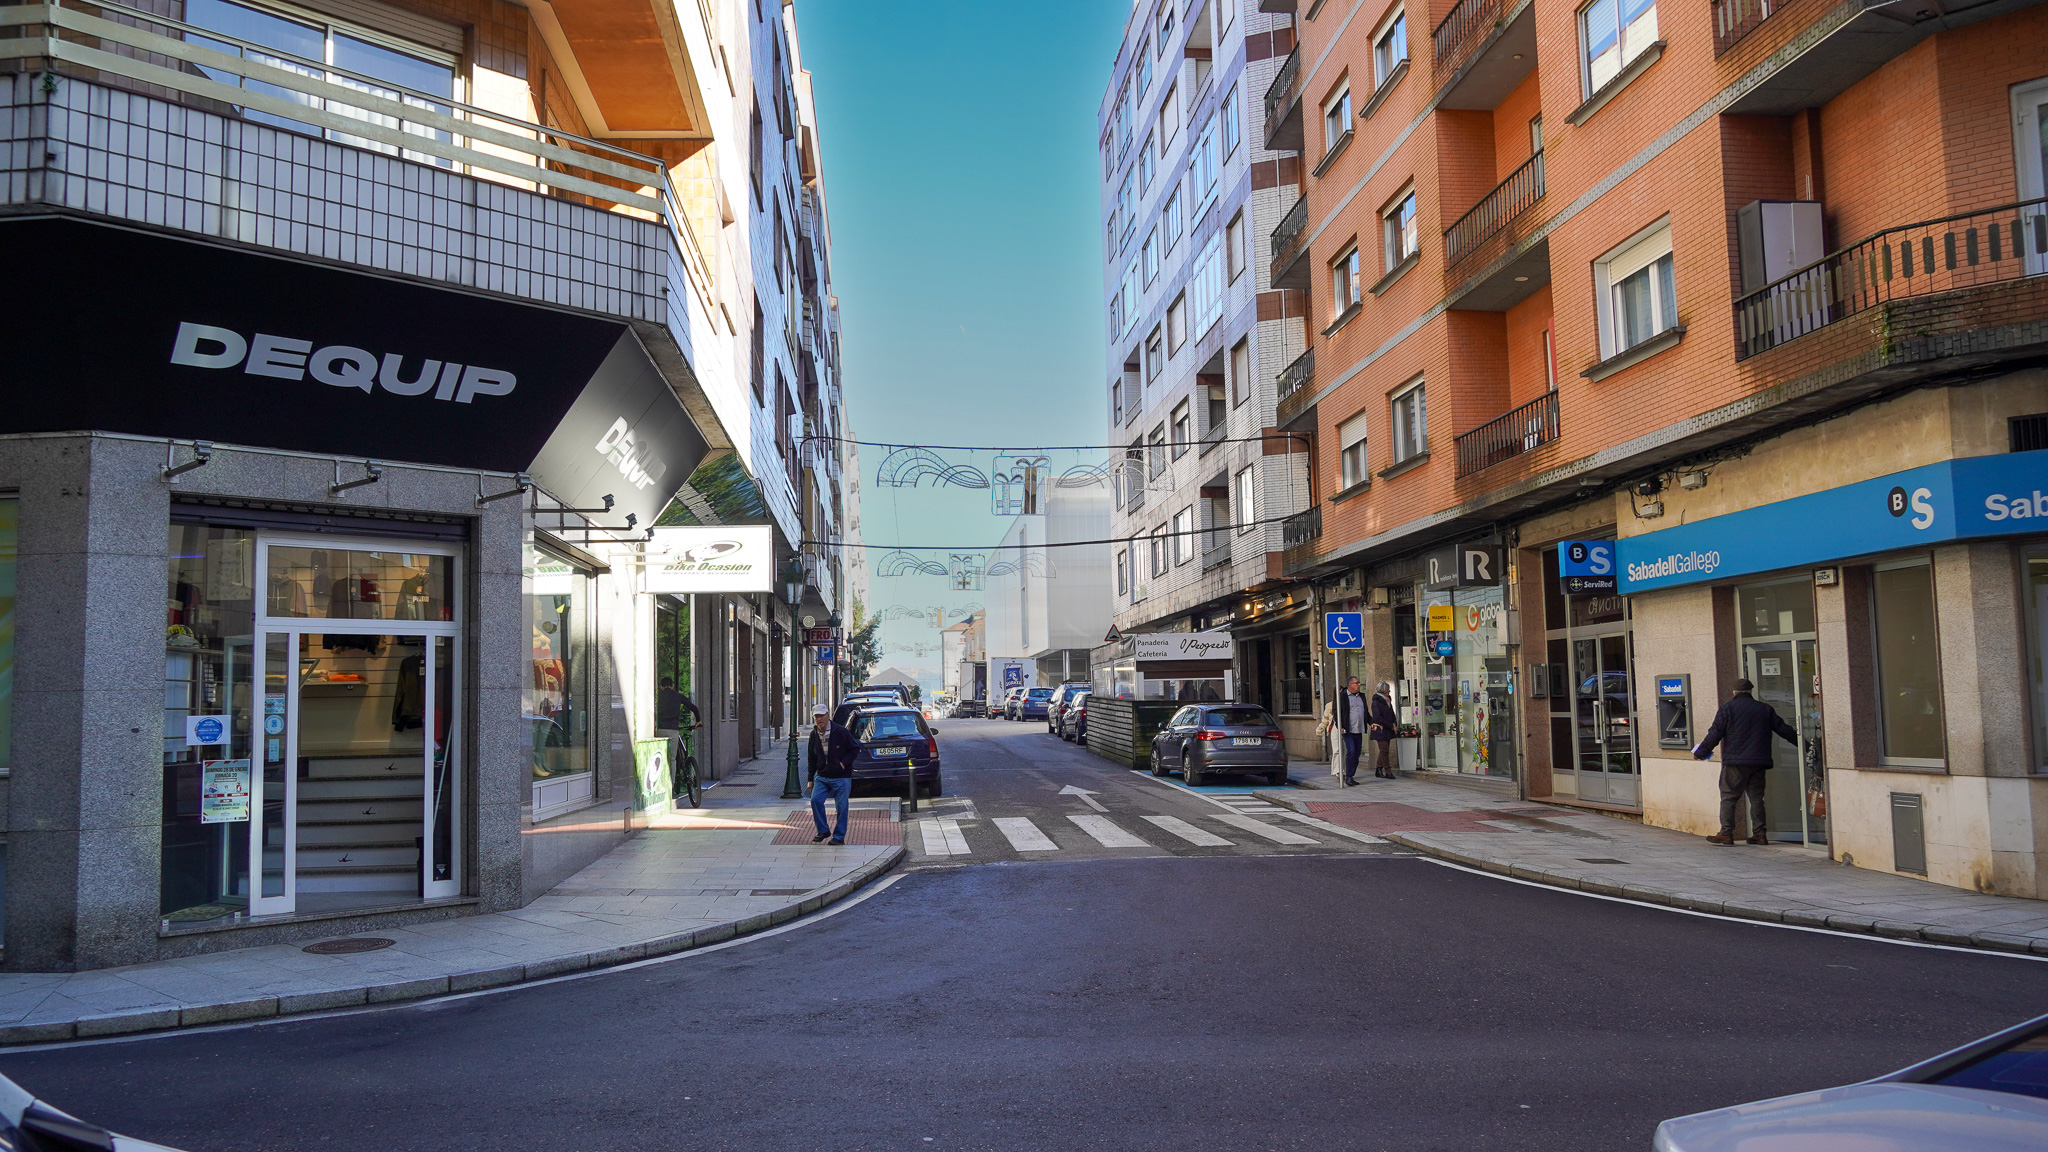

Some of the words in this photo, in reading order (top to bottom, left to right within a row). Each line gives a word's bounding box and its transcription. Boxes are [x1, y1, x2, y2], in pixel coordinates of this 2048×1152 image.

[170, 321, 517, 404] DEQUIP
[1892, 493, 1903, 511] B
[1911, 487, 1934, 530] S
[1985, 490, 2048, 521] Sab
[1429, 557, 1440, 585] R
[1465, 550, 1492, 580] R
[1573, 547, 1583, 559] B
[1590, 547, 1611, 575] S
[1627, 551, 1720, 582] SabadellGallego
[1584, 580, 1613, 588] ServiRed
[821, 646, 831, 658] P
